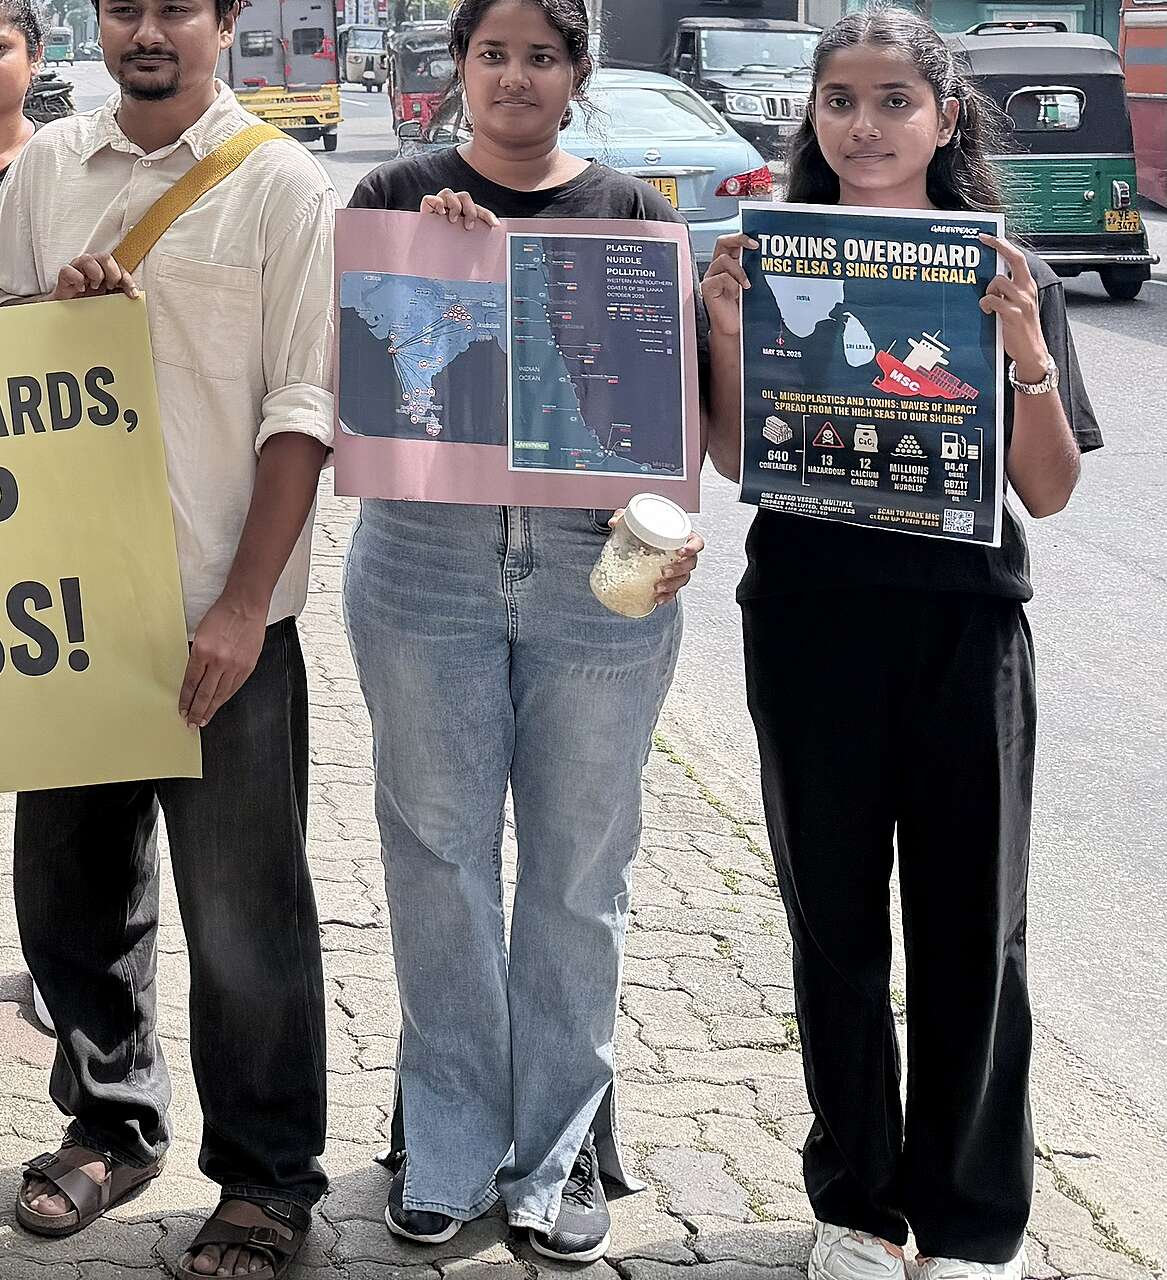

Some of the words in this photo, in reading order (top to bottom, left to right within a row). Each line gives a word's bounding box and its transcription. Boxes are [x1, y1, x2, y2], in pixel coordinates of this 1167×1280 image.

[606, 244, 643, 253] PLASTIC
[758, 234, 837, 259] TOXINS
[844, 239, 981, 267] OVERBOARD
[606, 255, 642, 265] NURDLE
[606, 267, 656, 278] POLLUTION
[761, 257, 792, 273] MSC
[796, 259, 830, 275] ELSA
[832, 261, 842, 276] 3
[845, 262, 888, 279] SINKS
[892, 265, 917, 281] OFF
[921, 267, 977, 284] KERALA
[889, 368, 920, 392] MSC
[779, 391, 846, 405] MICROPLASTICS
[847, 397, 864, 406] AND
[901, 400, 929, 411] WAVES
[931, 402, 943, 412] OF
[944, 404, 977, 415] IMPACT
[775, 401, 806, 413] SPREAD
[809, 404, 832, 415] FROM
[834, 406, 849, 416] THE
[852, 407, 872, 418] HIGH
[874, 409, 895, 420] SEAS
[896, 411, 907, 420] TO
[910, 412, 927, 422] OUR
[930, 413, 964, 425] SHORES
[767, 450, 789, 462] 640
[820, 454, 833, 466] 13
[759, 461, 798, 472] CONTAINERS
[859, 458, 871, 470] 12
[889, 463, 929, 476] MILLIONS
[807, 465, 846, 476] HAZARDOUS
[850, 469, 879, 479] CALCIUM
[850, 478, 879, 488] CARBIDE
[900, 474, 927, 484] PLASTIC
